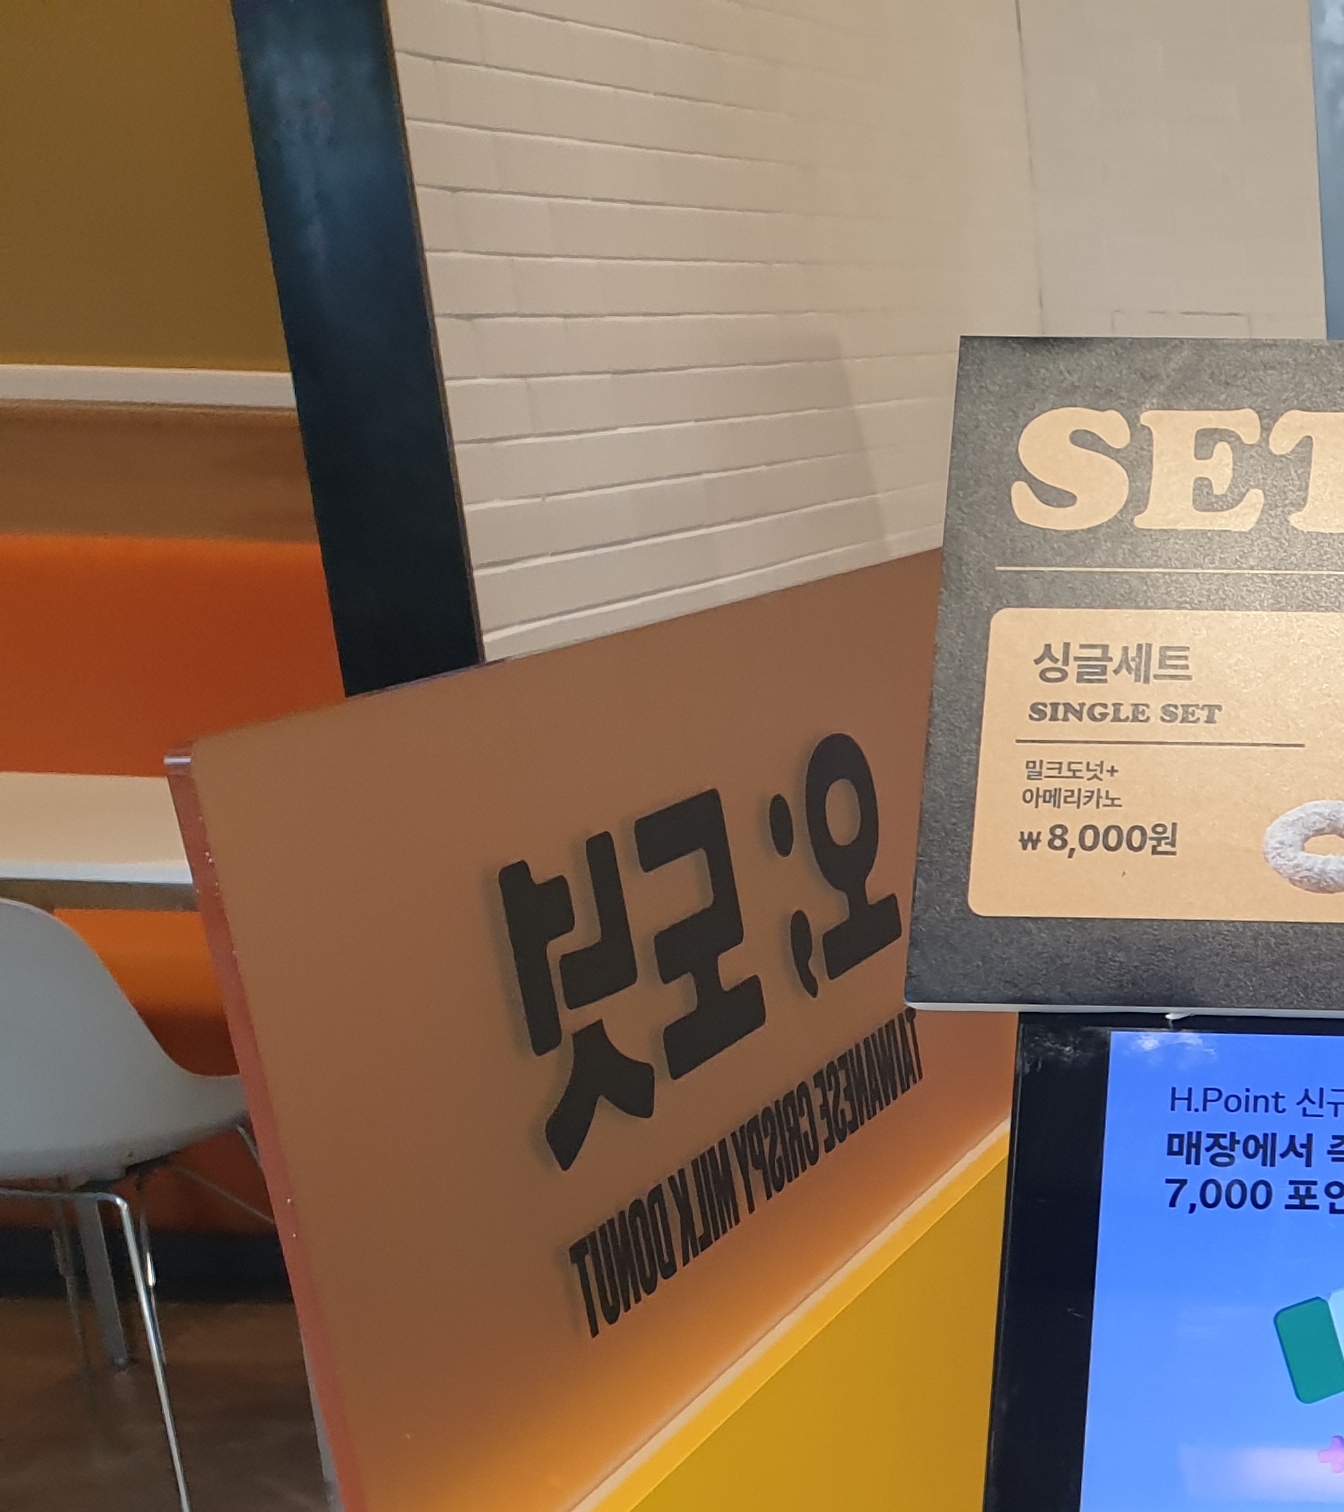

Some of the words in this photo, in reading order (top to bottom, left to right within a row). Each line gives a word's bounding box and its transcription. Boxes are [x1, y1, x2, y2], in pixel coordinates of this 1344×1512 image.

[1032, 641, 1194, 685] 싱글세트
[1028, 701, 1150, 724] SINGLE
[1160, 703, 1223, 725] SET
[1024, 759, 1120, 783] 밀크도넛+
[1021, 786, 1123, 810] 아메리카노
[1169, 1086, 1287, 1115] H.Point
[1166, 1130, 1314, 1169] 매장에서
[1163, 1178, 1273, 1215] 7,000
